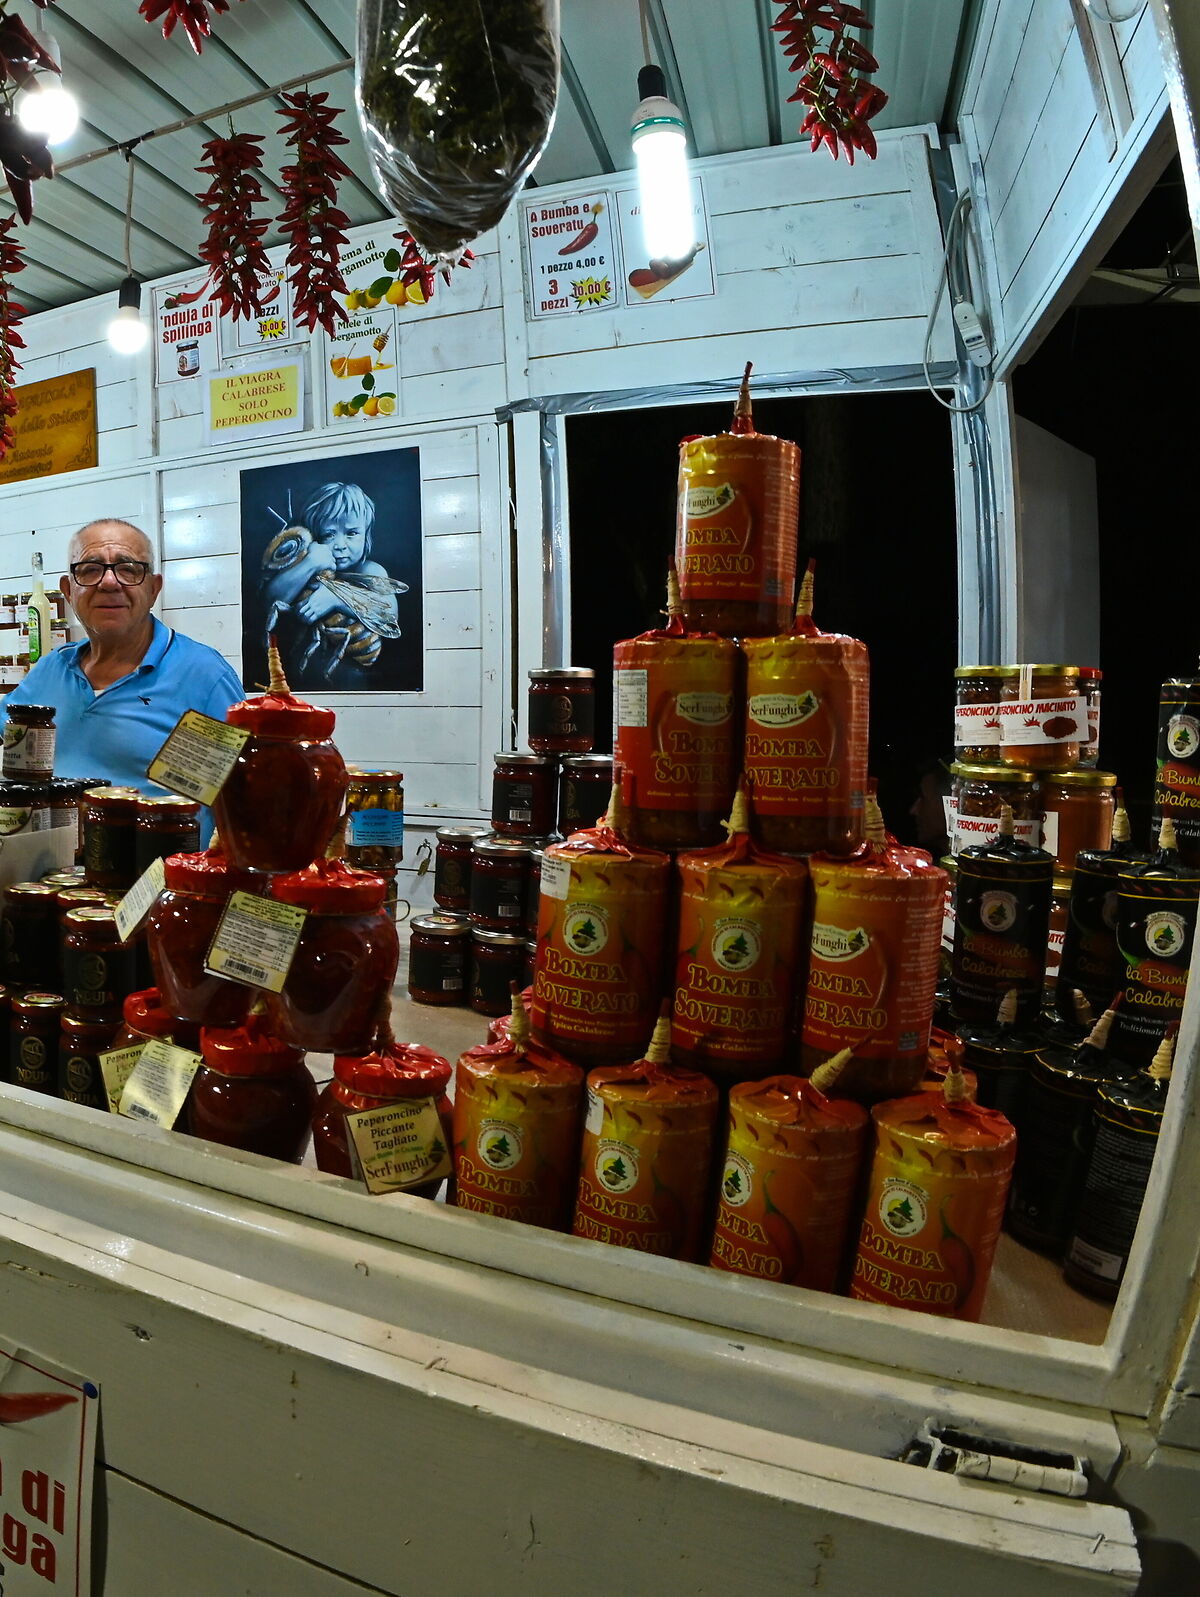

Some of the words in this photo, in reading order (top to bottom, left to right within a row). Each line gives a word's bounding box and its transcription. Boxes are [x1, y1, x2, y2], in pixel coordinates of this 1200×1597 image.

[541, 204, 580, 221] Bumba
[531, 219, 584, 238] Soveratu
[364, 240, 376, 252] di
[548, 262, 574, 274] pezzo
[548, 279, 559, 295] 3
[202, 303, 214, 319] di
[541, 297, 569, 312] pezzi
[364, 316, 373, 325] di
[162, 320, 212, 344] spilinga
[226, 378, 238, 390] IL
[240, 371, 282, 386] VIAGRA
[222, 382, 286, 402] CALABRESE
[238, 398, 268, 412] SOLO
[216, 407, 292, 428] PEPERONCINO
[686, 527, 740, 546] OMBA
[750, 703, 798, 719] SerFunghi
[746, 734, 826, 759] BOMBA
[746, 767, 840, 790] OVERATO
[544, 946, 628, 983] BOMBA
[1126, 964, 1142, 982] la
[688, 962, 777, 999] BOMBA
[808, 968, 873, 998] OMBA
[536, 970, 640, 1014] SOVERATO
[805, 996, 888, 1030] VERATO
[357, 1106, 422, 1128] Peperoncino
[370, 1121, 415, 1139] Piccante
[373, 1134, 418, 1151] Tagliato
[365, 1154, 429, 1180] SerFunghi
[459, 1155, 540, 1198] BOMBA
[579, 1177, 658, 1224] BOMBA
[718, 1204, 769, 1246] MBA
[712, 1232, 782, 1278] ERATO
[859, 1219, 945, 1272] BOMBA
[853, 1254, 958, 1304] OVERATO
[22, 1469, 65, 1536] di
